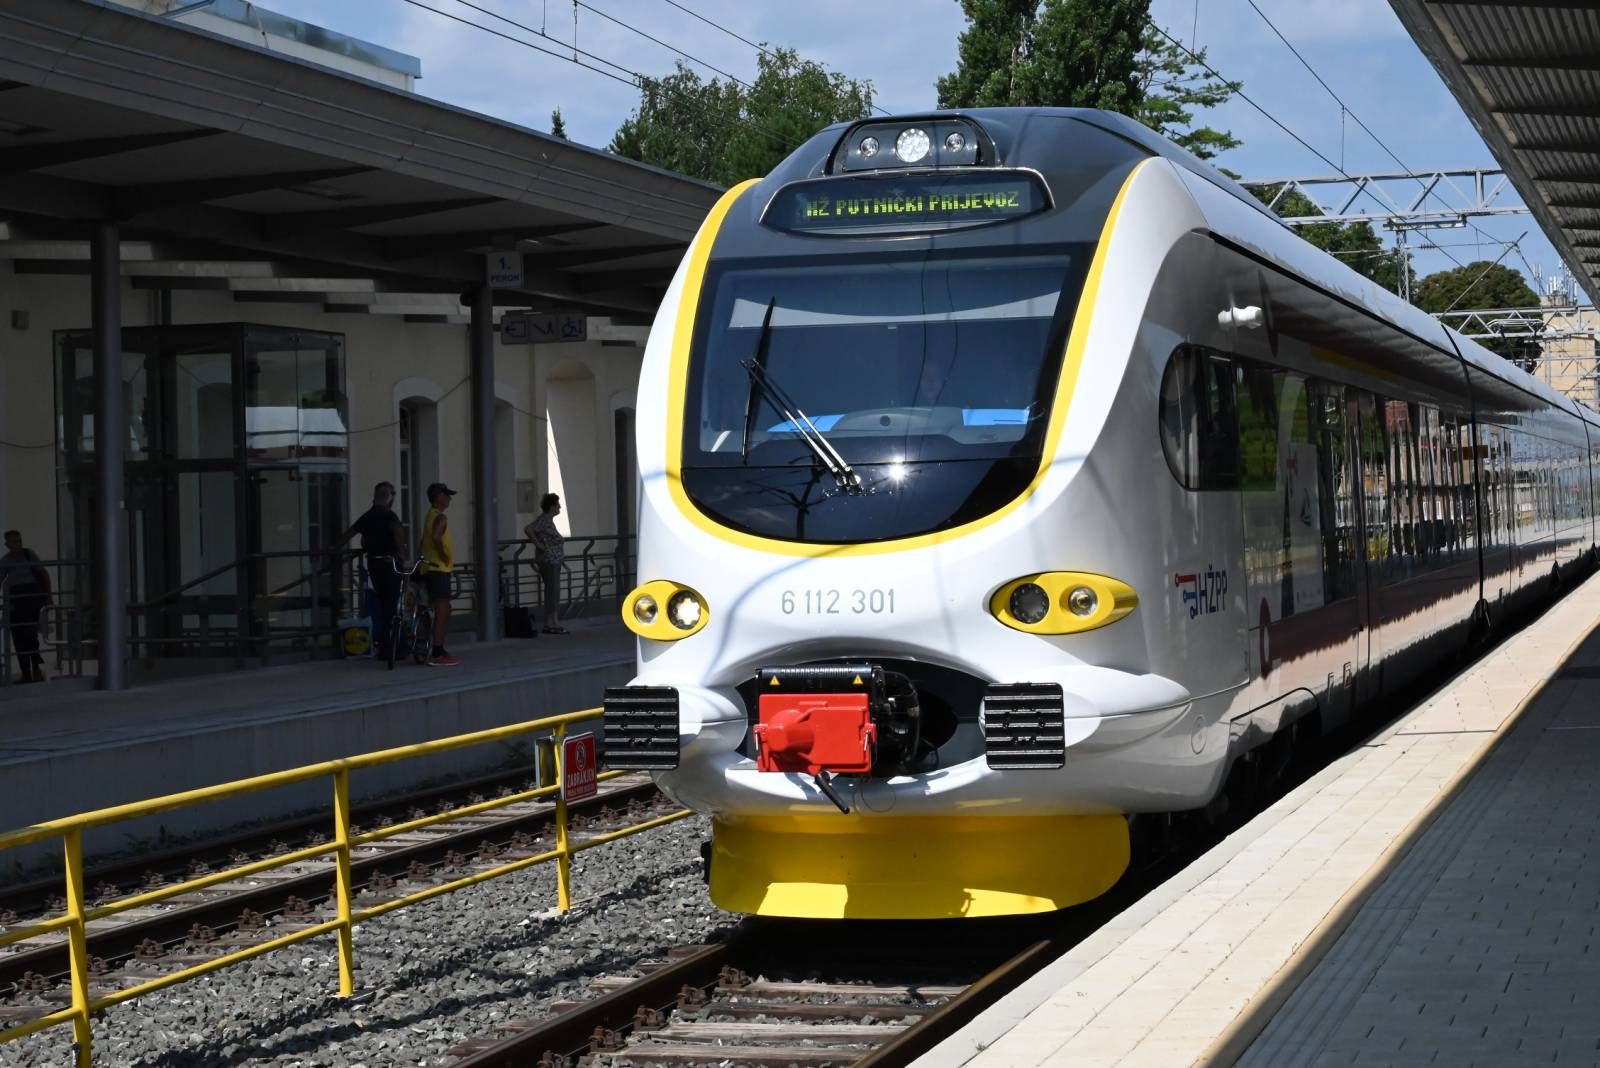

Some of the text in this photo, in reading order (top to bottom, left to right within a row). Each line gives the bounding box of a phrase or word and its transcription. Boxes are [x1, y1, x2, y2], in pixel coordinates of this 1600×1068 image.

[929, 191, 1019, 211] PRIJEVOZ
[781, 588, 895, 615] 6 112 301
[1198, 563, 1228, 615] HŽPP
